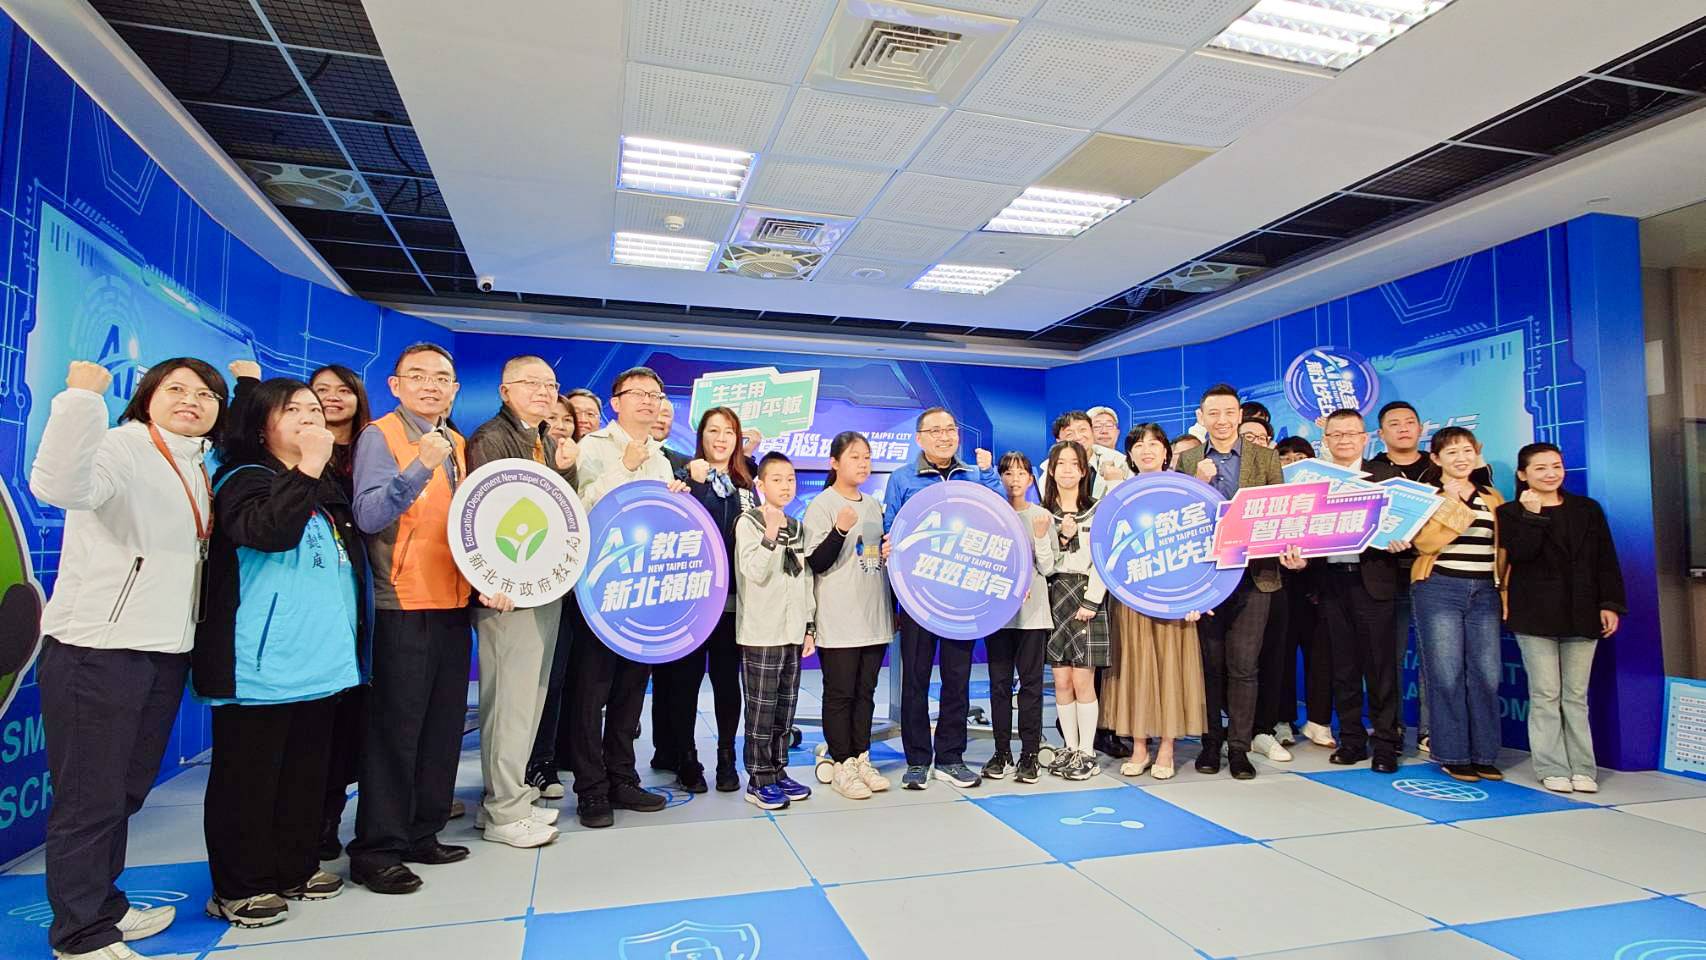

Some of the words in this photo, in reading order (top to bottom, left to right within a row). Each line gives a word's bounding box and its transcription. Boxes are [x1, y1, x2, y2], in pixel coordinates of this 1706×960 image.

[711, 381, 766, 401] 生生用
[871, 431, 894, 440] TAIPEI
[896, 433, 912, 441] CITY
[501, 473, 518, 482] New
[518, 473, 539, 484] Taipei
[539, 478, 553, 491] City
[467, 475, 502, 509] Department
[1242, 493, 1316, 519] 班班有
[551, 487, 577, 530] Government
[1154, 501, 1212, 537] 教室
[463, 509, 475, 548] Education
[1159, 535, 1177, 546] NEW
[1177, 530, 1198, 541] TAIPEI
[1199, 524, 1214, 535] CITY
[1250, 509, 1368, 542] 智慧電視
[650, 529, 704, 560] 教育
[960, 527, 1014, 562] 電腦
[647, 563, 665, 573] NEW
[666, 561, 688, 571] TAIPEI
[689, 560, 703, 569] CITY
[912, 553, 1014, 600] 班班都有
[954, 552, 970, 564] NEW
[971, 557, 992, 569] TAIPEI
[992, 562, 1008, 573] CITY
[600, 569, 713, 613] 新北領航
